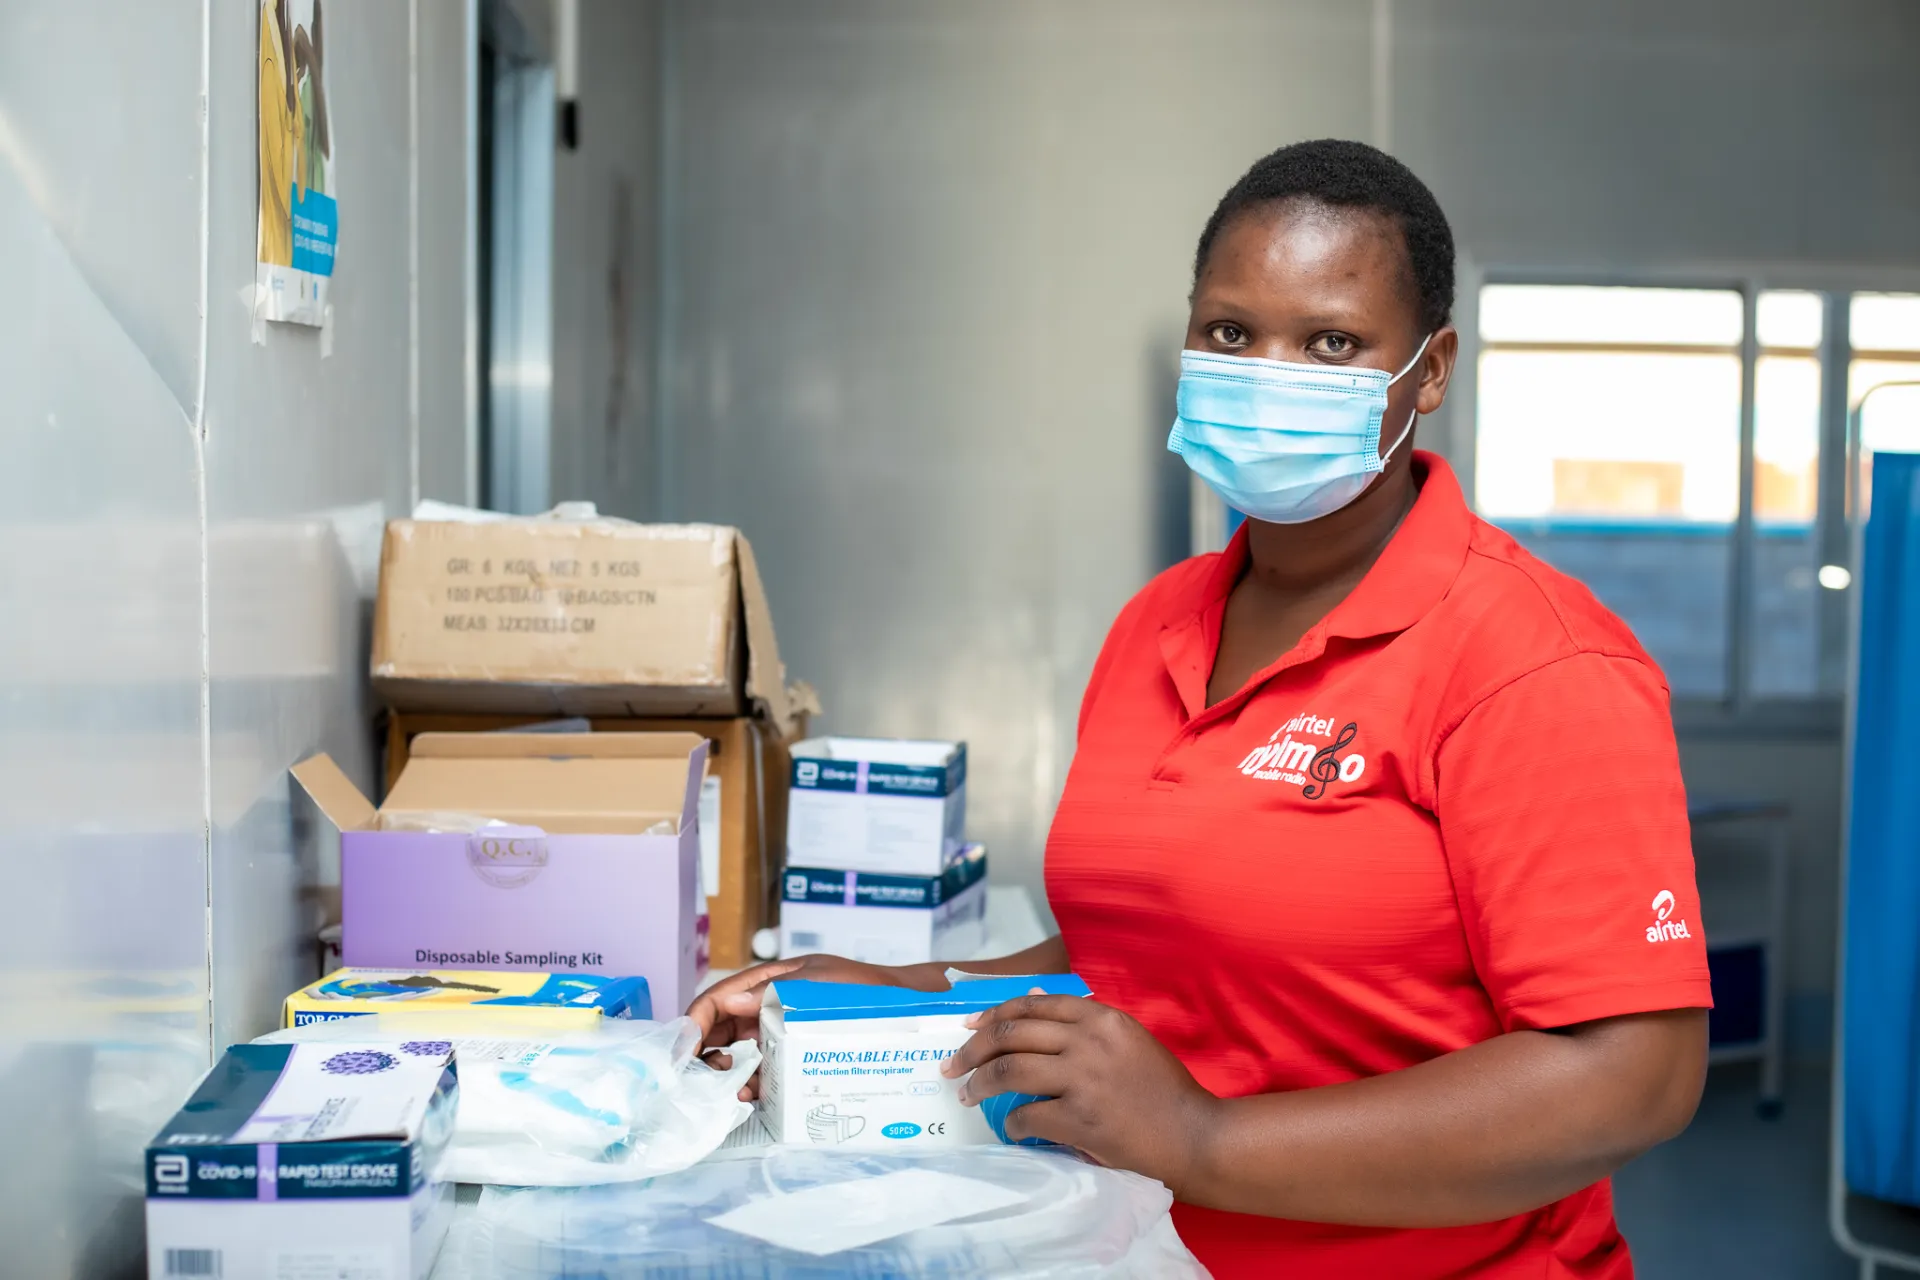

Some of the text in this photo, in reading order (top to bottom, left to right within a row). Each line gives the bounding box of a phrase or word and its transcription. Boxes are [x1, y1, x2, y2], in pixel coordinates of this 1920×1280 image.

[607, 561, 641, 577] KGS
[1286, 712, 1335, 737] airtel
[1253, 769, 1307, 786] mobile radio
[1645, 919, 1692, 943] airtel
[415, 949, 603, 968] Disposable Sampling Kit
[803, 1050, 890, 1064] DISPOSABLE
[893, 1050, 929, 1062] FACE
[802, 1067, 914, 1077] Self suction filter respirator
[198, 1166, 258, 1179] COVID-19
[278, 1164, 317, 1180] RAPID
[319, 1164, 350, 1180] TEST
[351, 1163, 399, 1179] DEVICE
